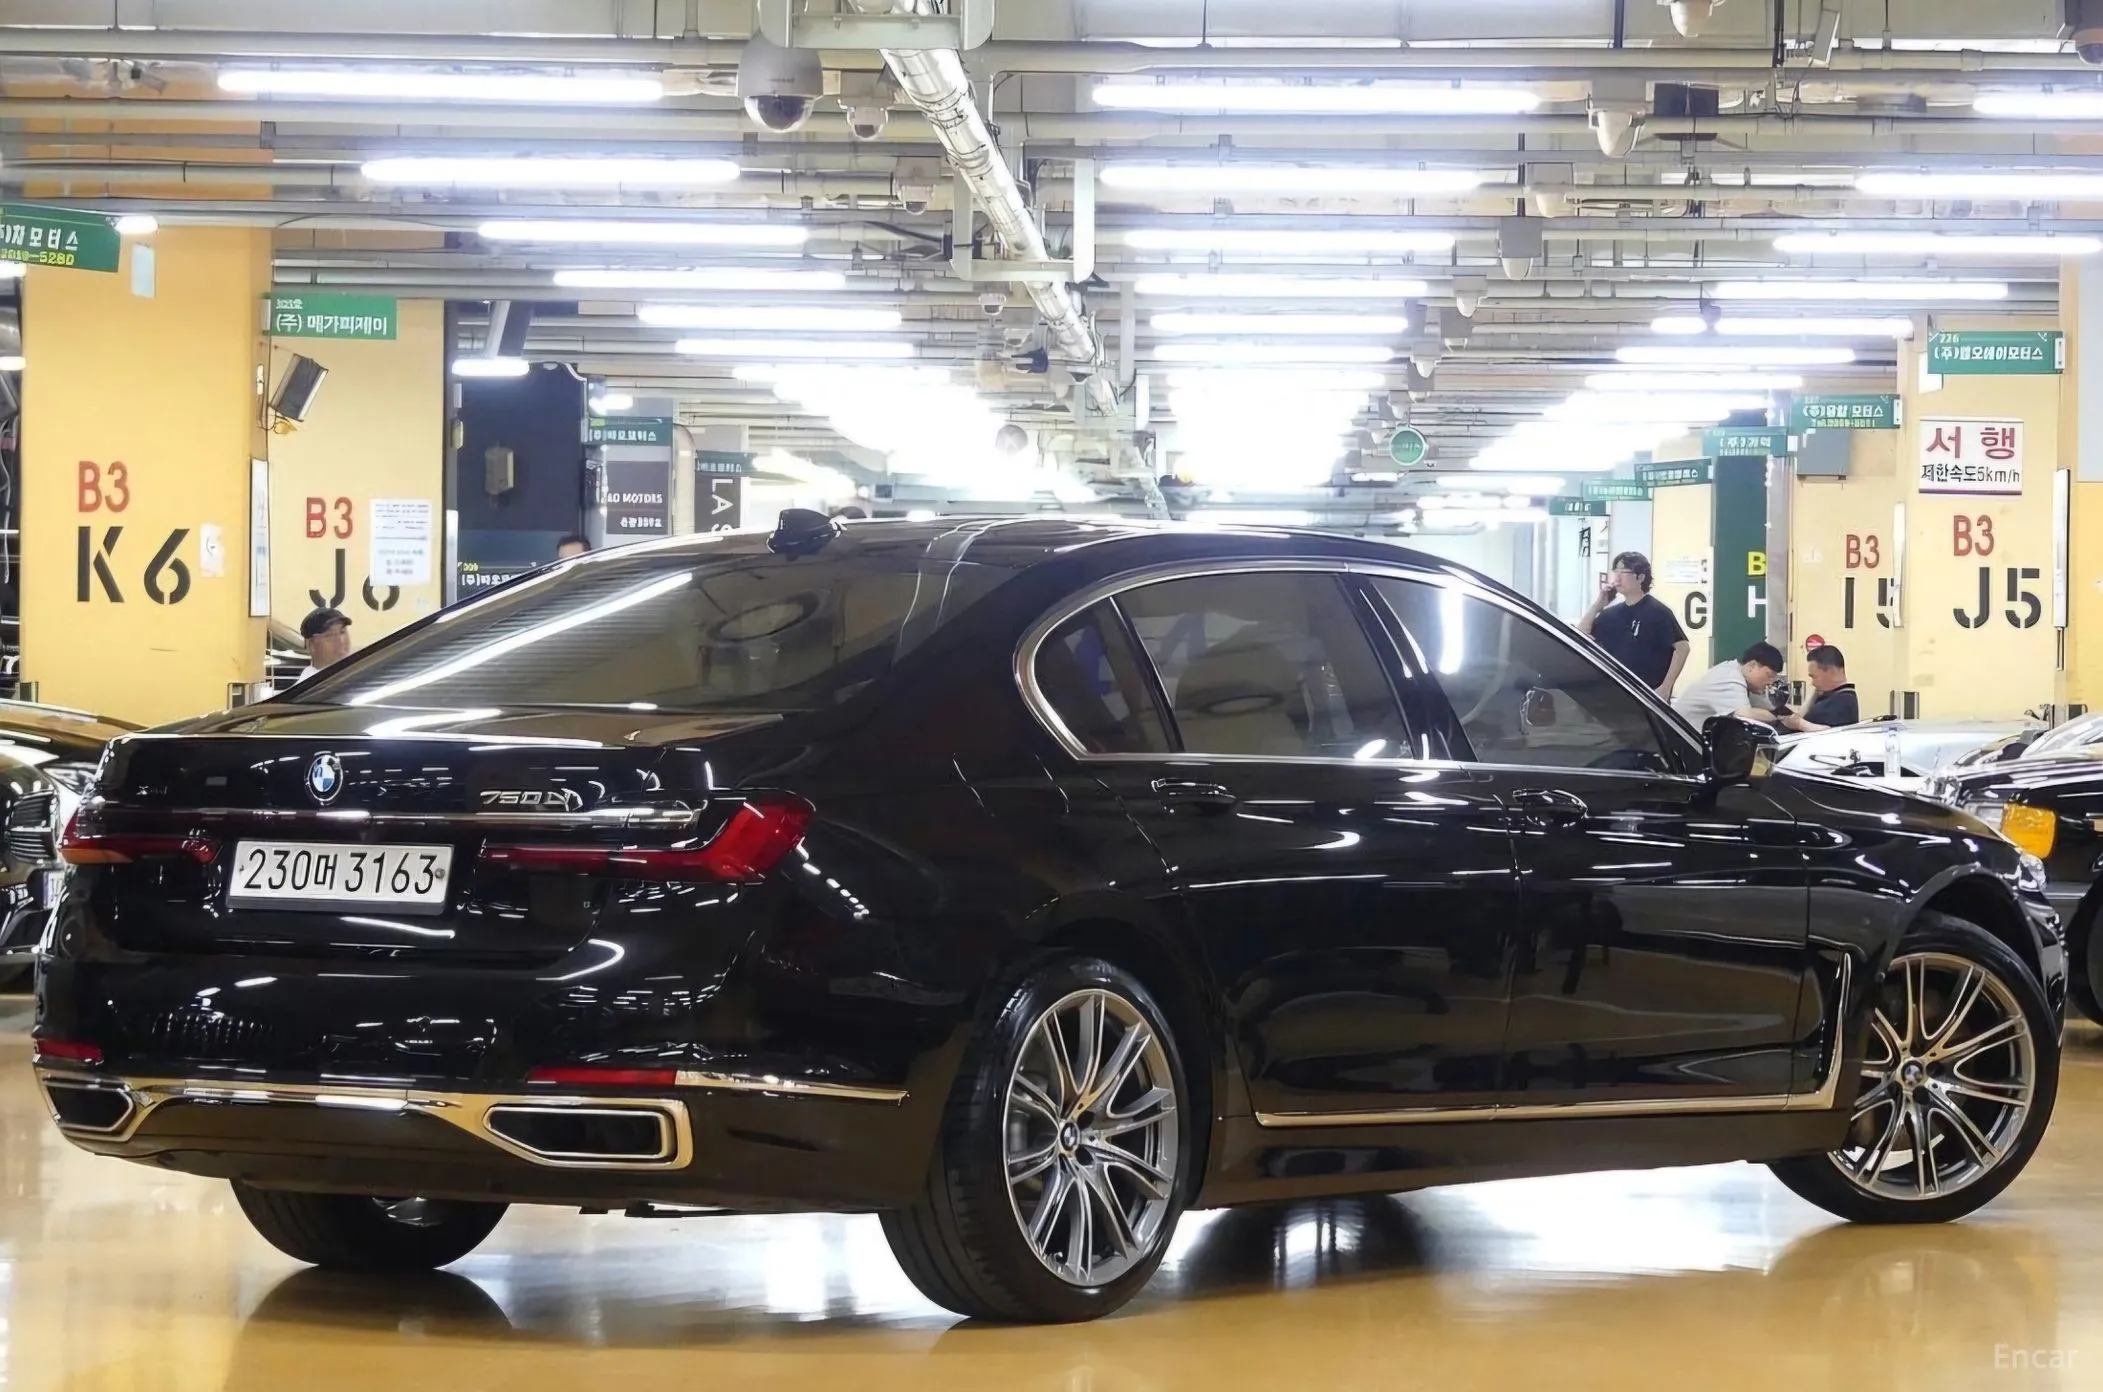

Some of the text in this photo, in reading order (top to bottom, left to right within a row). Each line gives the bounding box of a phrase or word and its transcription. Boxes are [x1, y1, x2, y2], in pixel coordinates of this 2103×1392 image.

[78, 460, 131, 513] B3
[306, 496, 354, 539] B3
[1953, 514, 1995, 557] B3
[1845, 534, 1880, 569] B3
